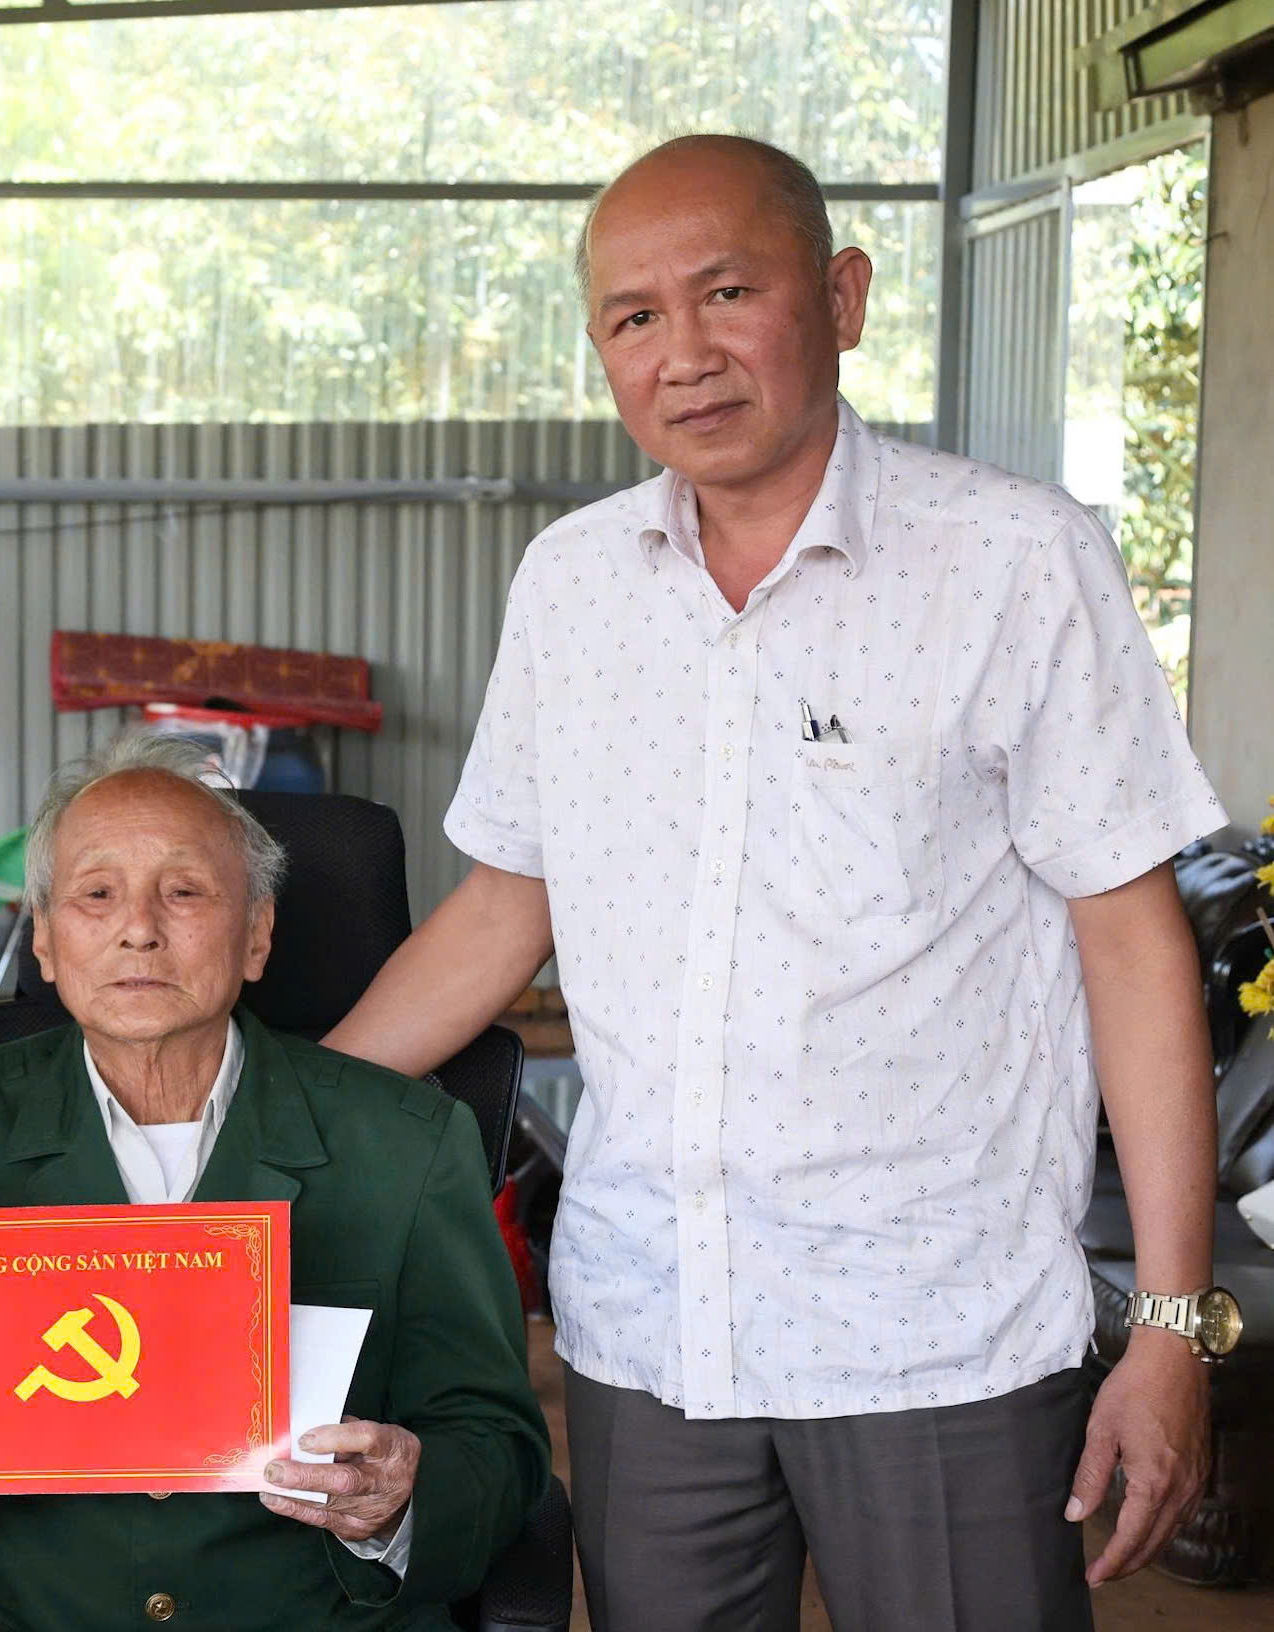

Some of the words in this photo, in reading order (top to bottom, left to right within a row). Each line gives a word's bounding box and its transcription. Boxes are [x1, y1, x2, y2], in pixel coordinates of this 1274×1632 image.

[12, 1254, 72, 1277] CỘNG
[76, 1250, 117, 1272] SẢN
[121, 1250, 170, 1274] VIỆT
[174, 1251, 223, 1269] NAM
